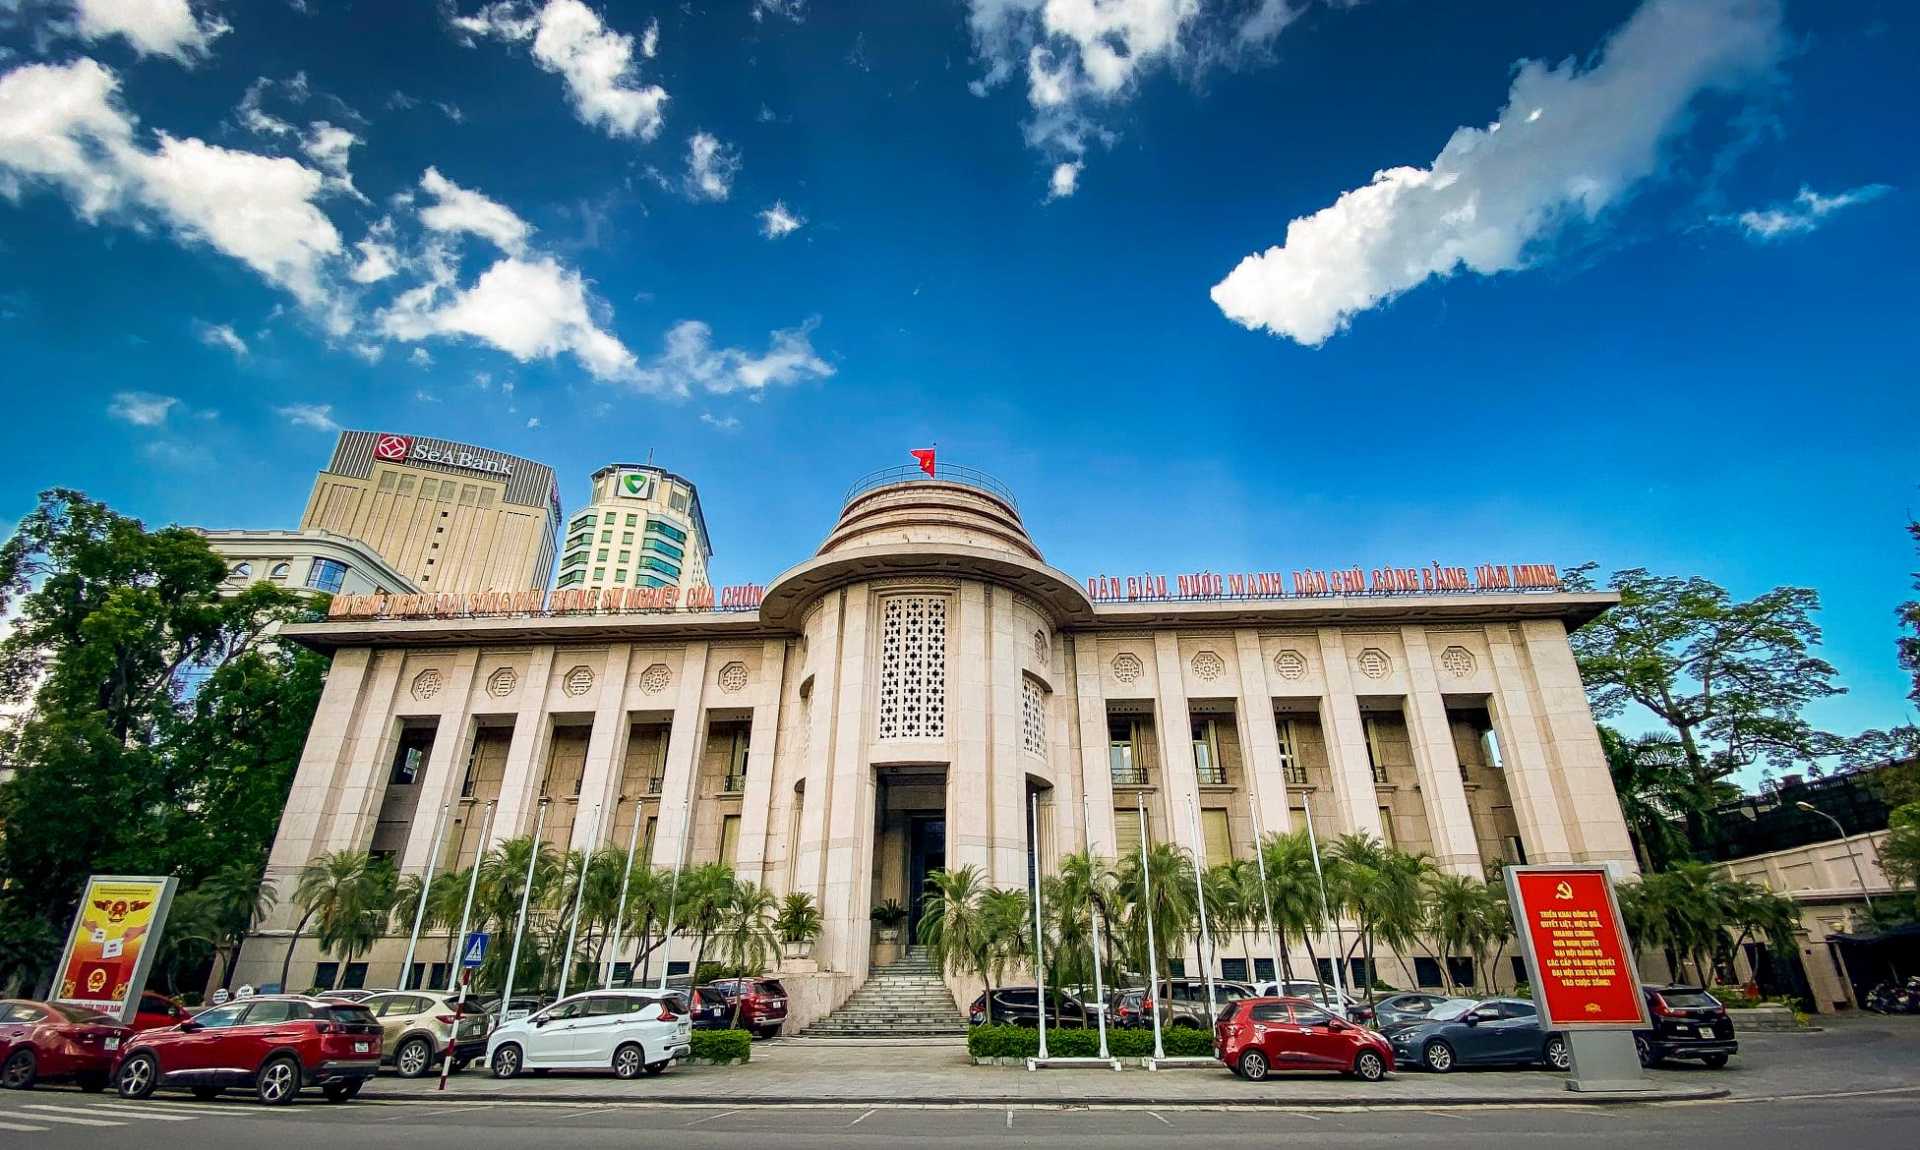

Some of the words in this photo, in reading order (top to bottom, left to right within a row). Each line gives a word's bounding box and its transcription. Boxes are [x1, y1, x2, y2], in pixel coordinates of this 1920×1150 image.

[413, 444, 514, 475] SeABank
[1088, 574, 1121, 598] DÂN
[1177, 570, 1223, 596] NƯỚC
[1292, 568, 1328, 594] DÂN
[1372, 566, 1419, 590] CÔNG
[1474, 562, 1511, 588] VĂN
[1511, 565, 1559, 587] MINH
[468, 587, 510, 613] SỐNG
[549, 588, 597, 612] TRONG
[625, 585, 681, 609] NGHIỆP
[686, 582, 716, 608] CỦA
[721, 582, 767, 607] CHÚN
